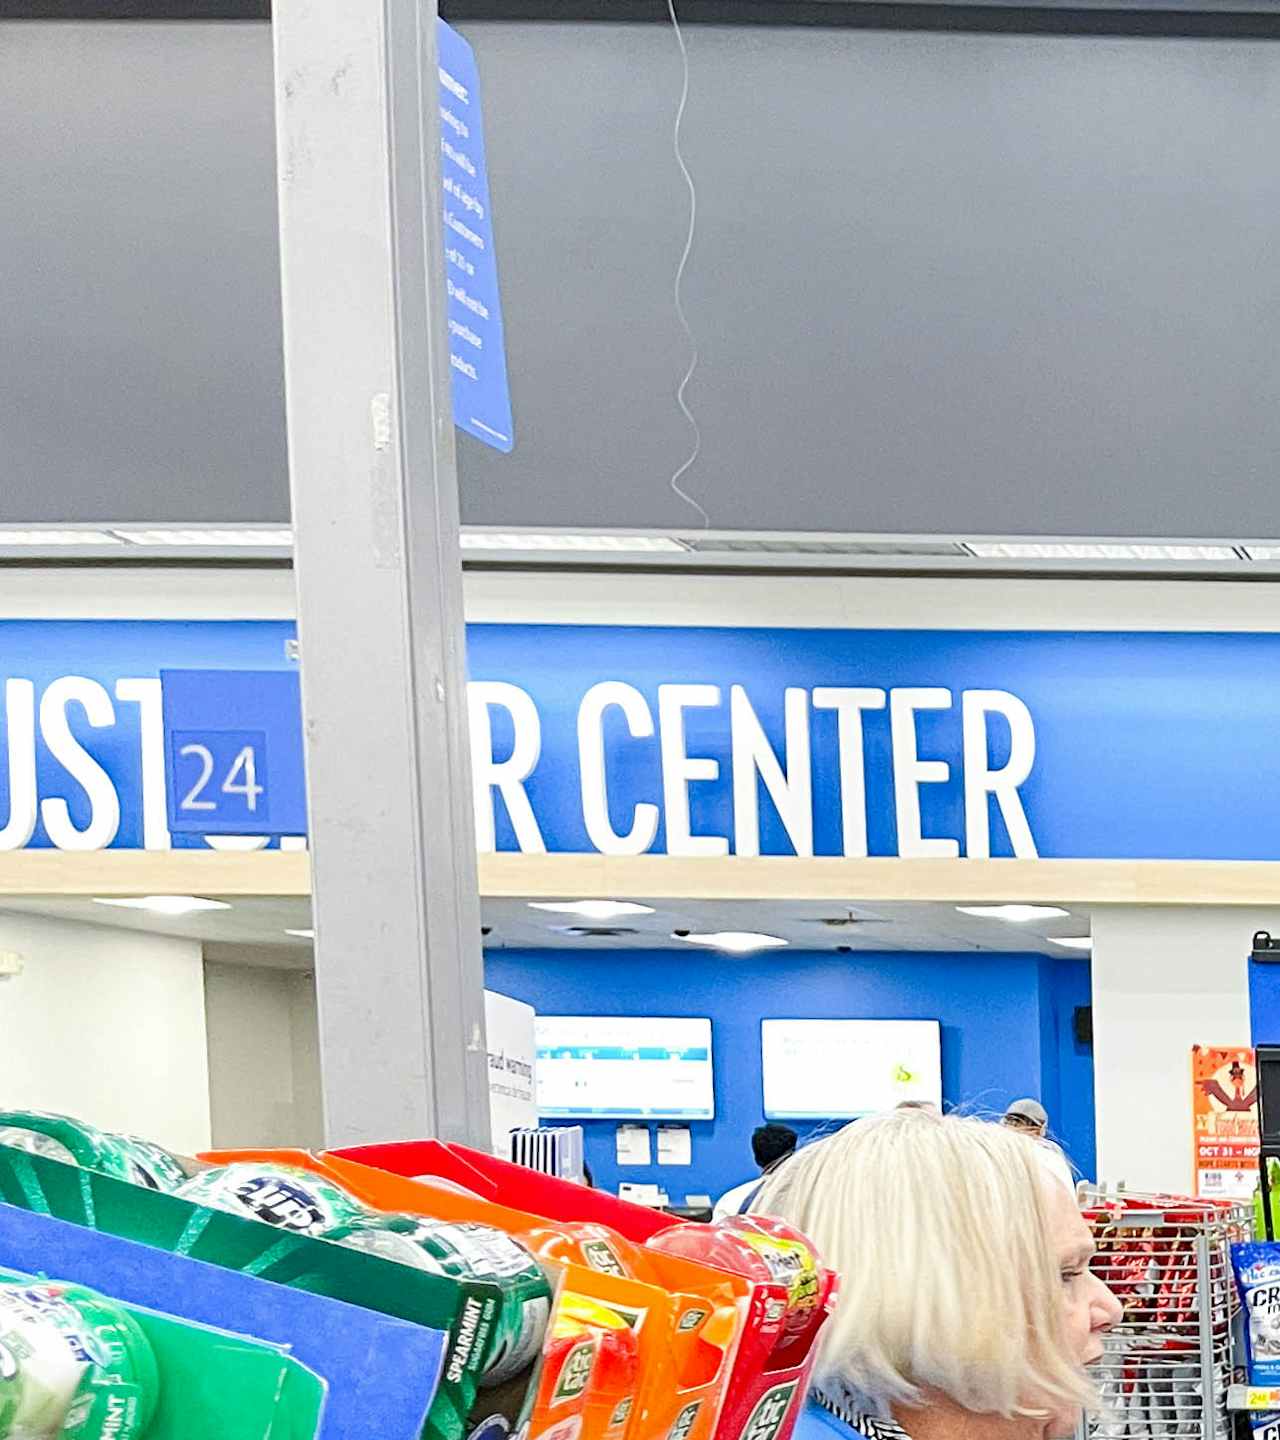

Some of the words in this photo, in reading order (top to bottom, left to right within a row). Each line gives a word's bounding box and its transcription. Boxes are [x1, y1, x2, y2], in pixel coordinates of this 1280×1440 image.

[180, 744, 263, 811] 24
[577, 680, 1040, 858] CENTER
[445, 1296, 484, 1384] SPEARMINT
